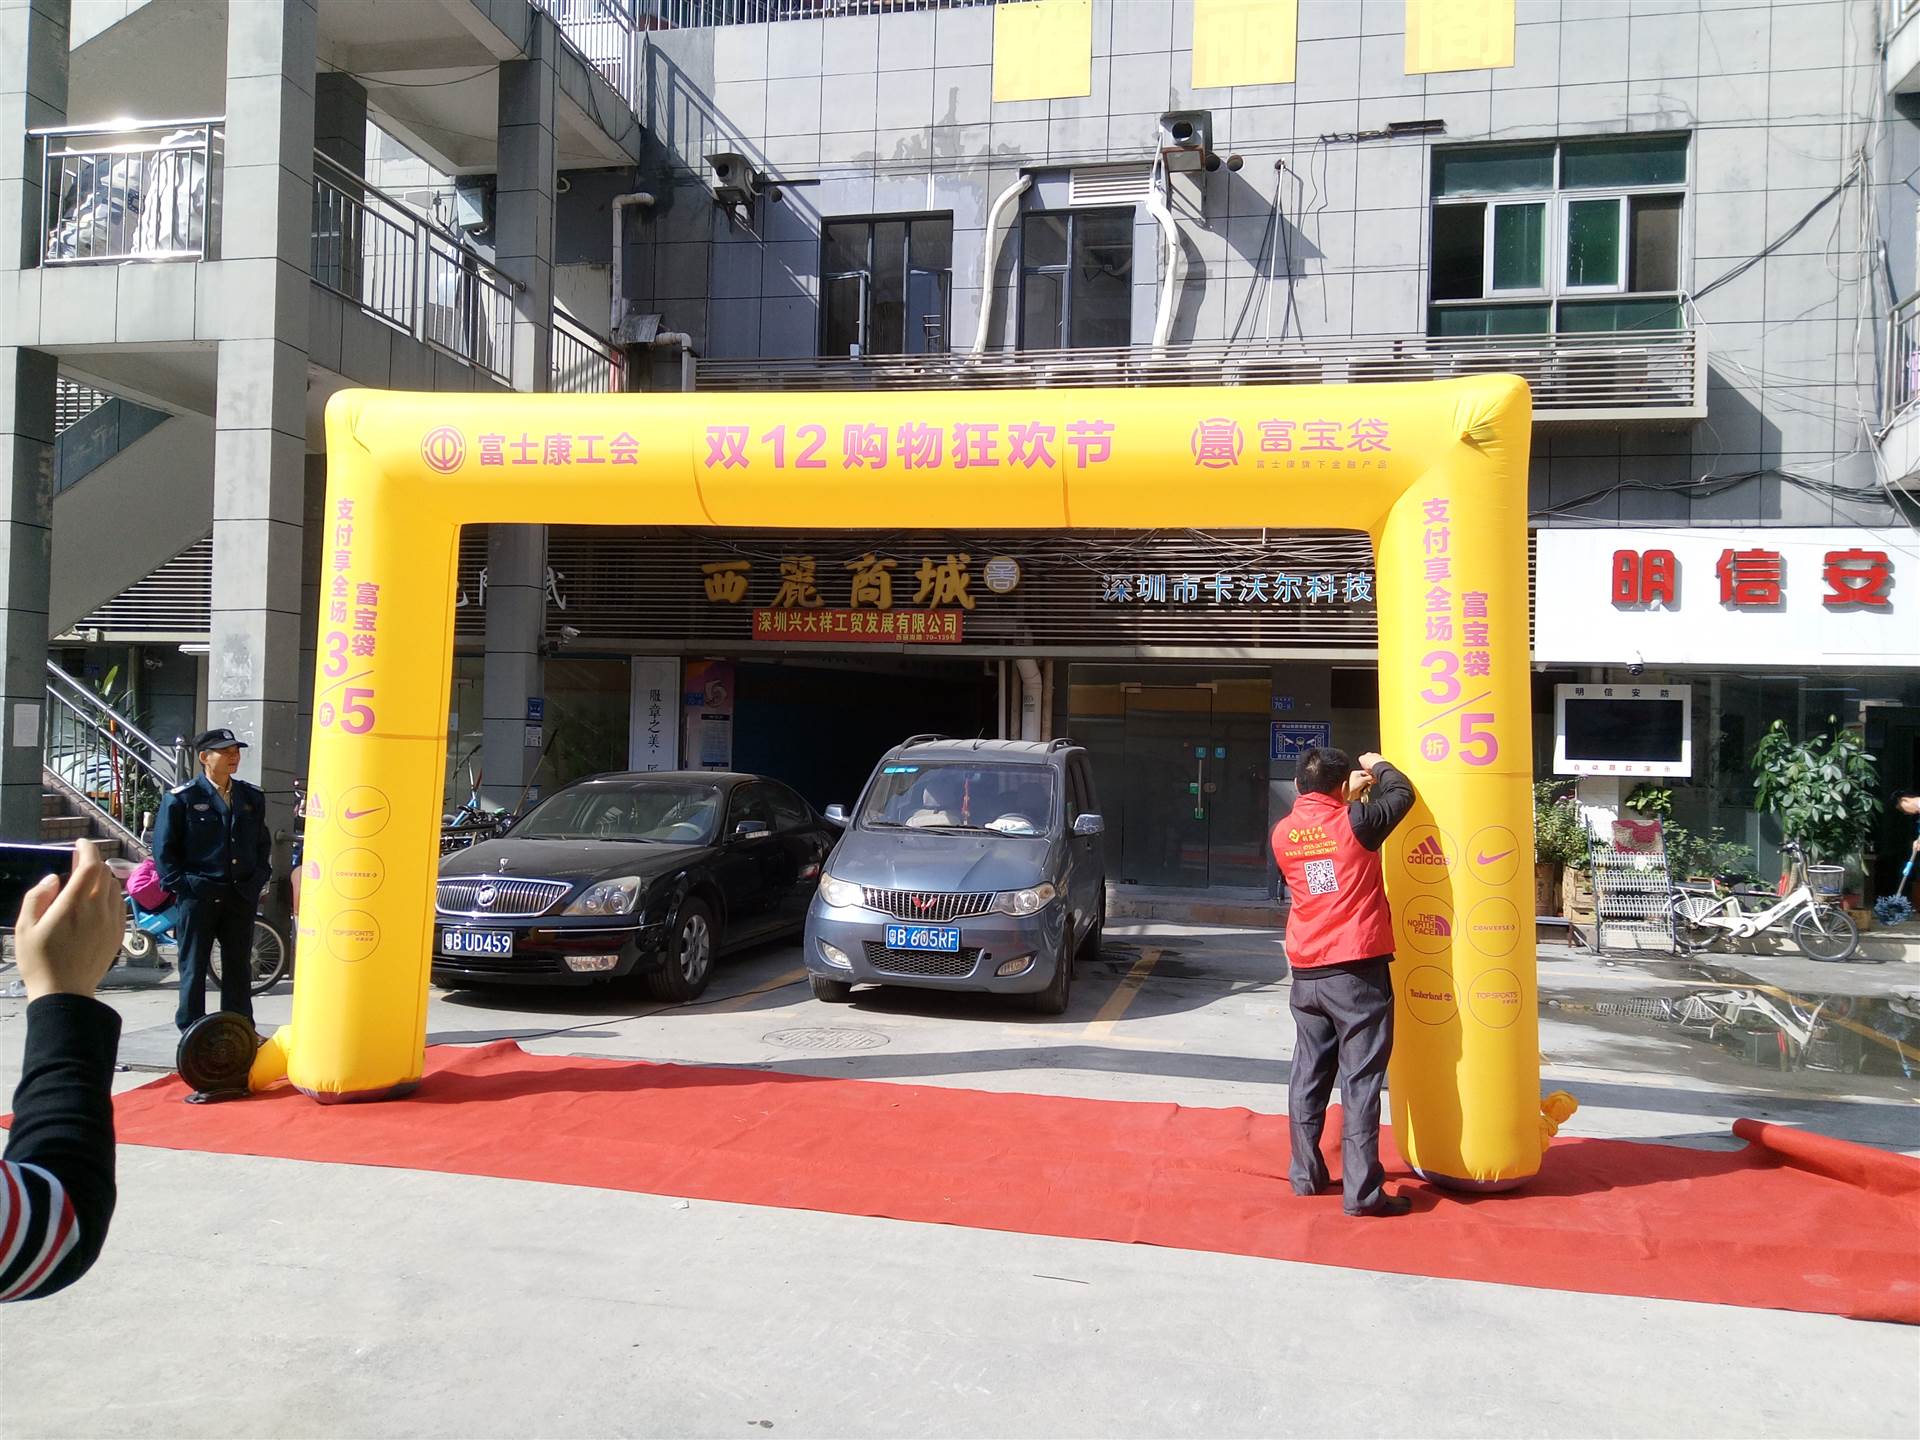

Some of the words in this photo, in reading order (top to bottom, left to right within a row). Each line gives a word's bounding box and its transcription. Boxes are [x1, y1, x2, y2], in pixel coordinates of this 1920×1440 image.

[478, 433, 640, 467] 富士康工会
[705, 420, 1115, 469] 双12购物狂欢节
[1257, 418, 1392, 453] 富宝袋
[330, 498, 354, 624] 支付享全场
[1423, 497, 1452, 641] 支付享全场
[1101, 573, 1374, 604] 深圳市卡沃尔科技
[1612, 547, 1891, 609] 明信安
[351, 582, 380, 657] 富宝袋
[757, 612, 957, 634] 深圳兴大祥工贸发展有限公司
[1461, 592, 1490, 677] 富宝袋
[1575, 687, 1670, 698] 明信安防
[1407, 854, 1451, 866] adidas
[1407, 920, 1434, 928] NORTH
[1414, 927, 1435, 936] FACE
[1419, 913, 1435, 921] THE
[1410, 988, 1443, 1001] Timberland
